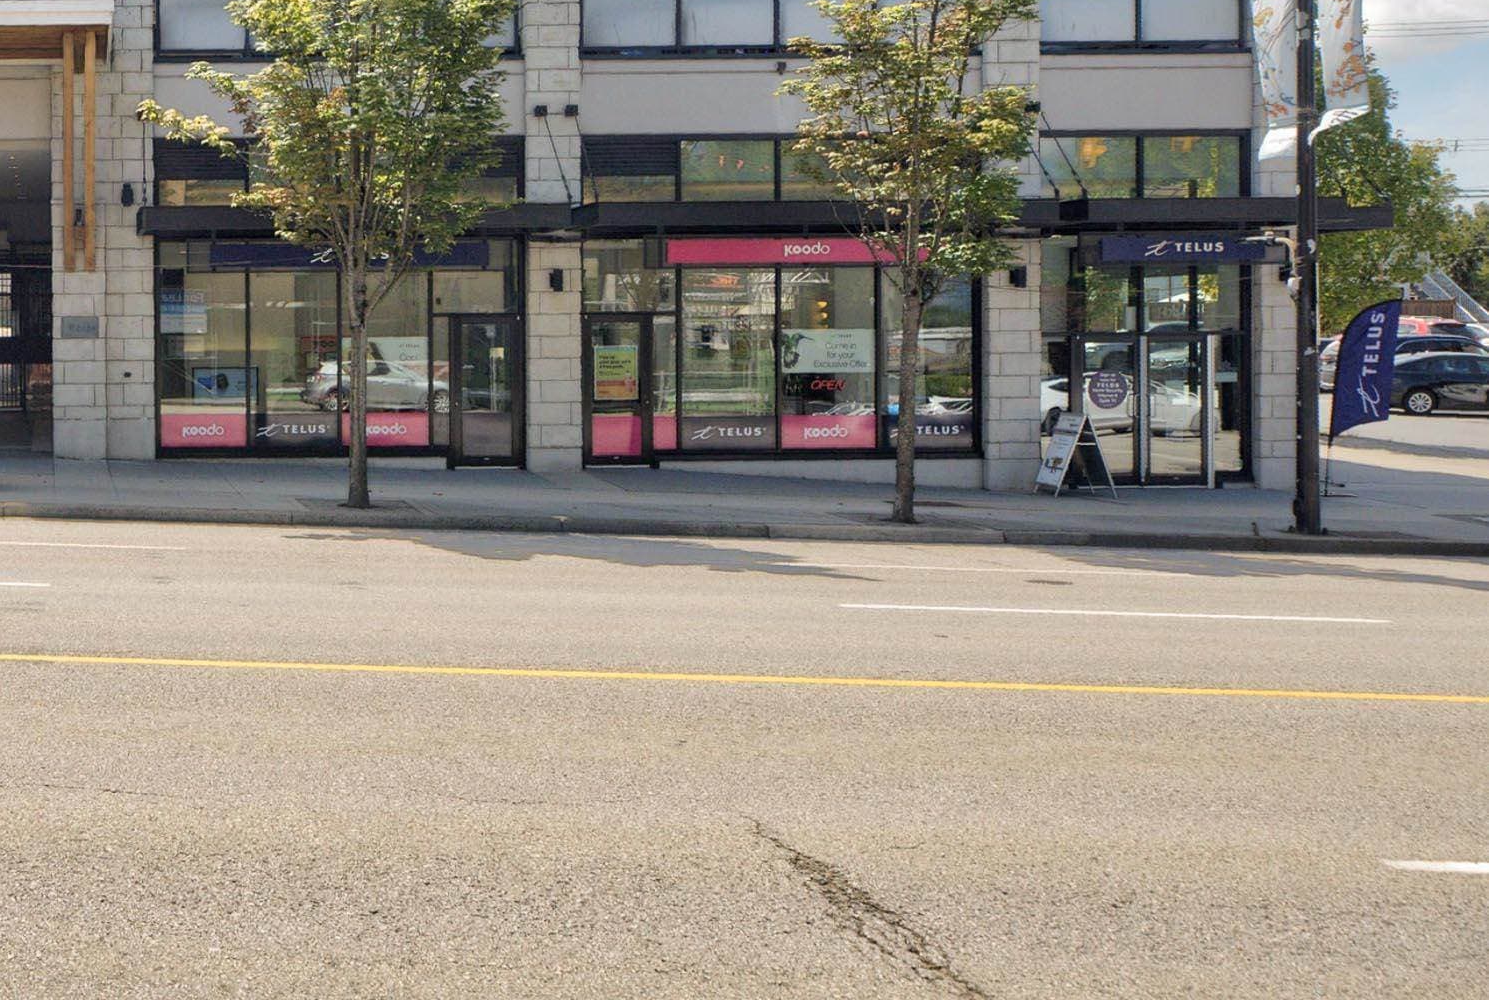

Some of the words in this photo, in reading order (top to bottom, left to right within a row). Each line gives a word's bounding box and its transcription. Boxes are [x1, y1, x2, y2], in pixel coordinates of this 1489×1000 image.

[784, 242, 830, 257] koodo
[1174, 241, 1225, 253] TELUS
[1362, 312, 1386, 377] TELUS
[811, 379, 846, 391] OPEN
[182, 423, 224, 438] koodo
[282, 424, 327, 434] TELUS
[365, 422, 406, 436] koodo
[718, 427, 763, 437] TELUS
[803, 424, 848, 440] koodo
[915, 425, 961, 436] TELUS
